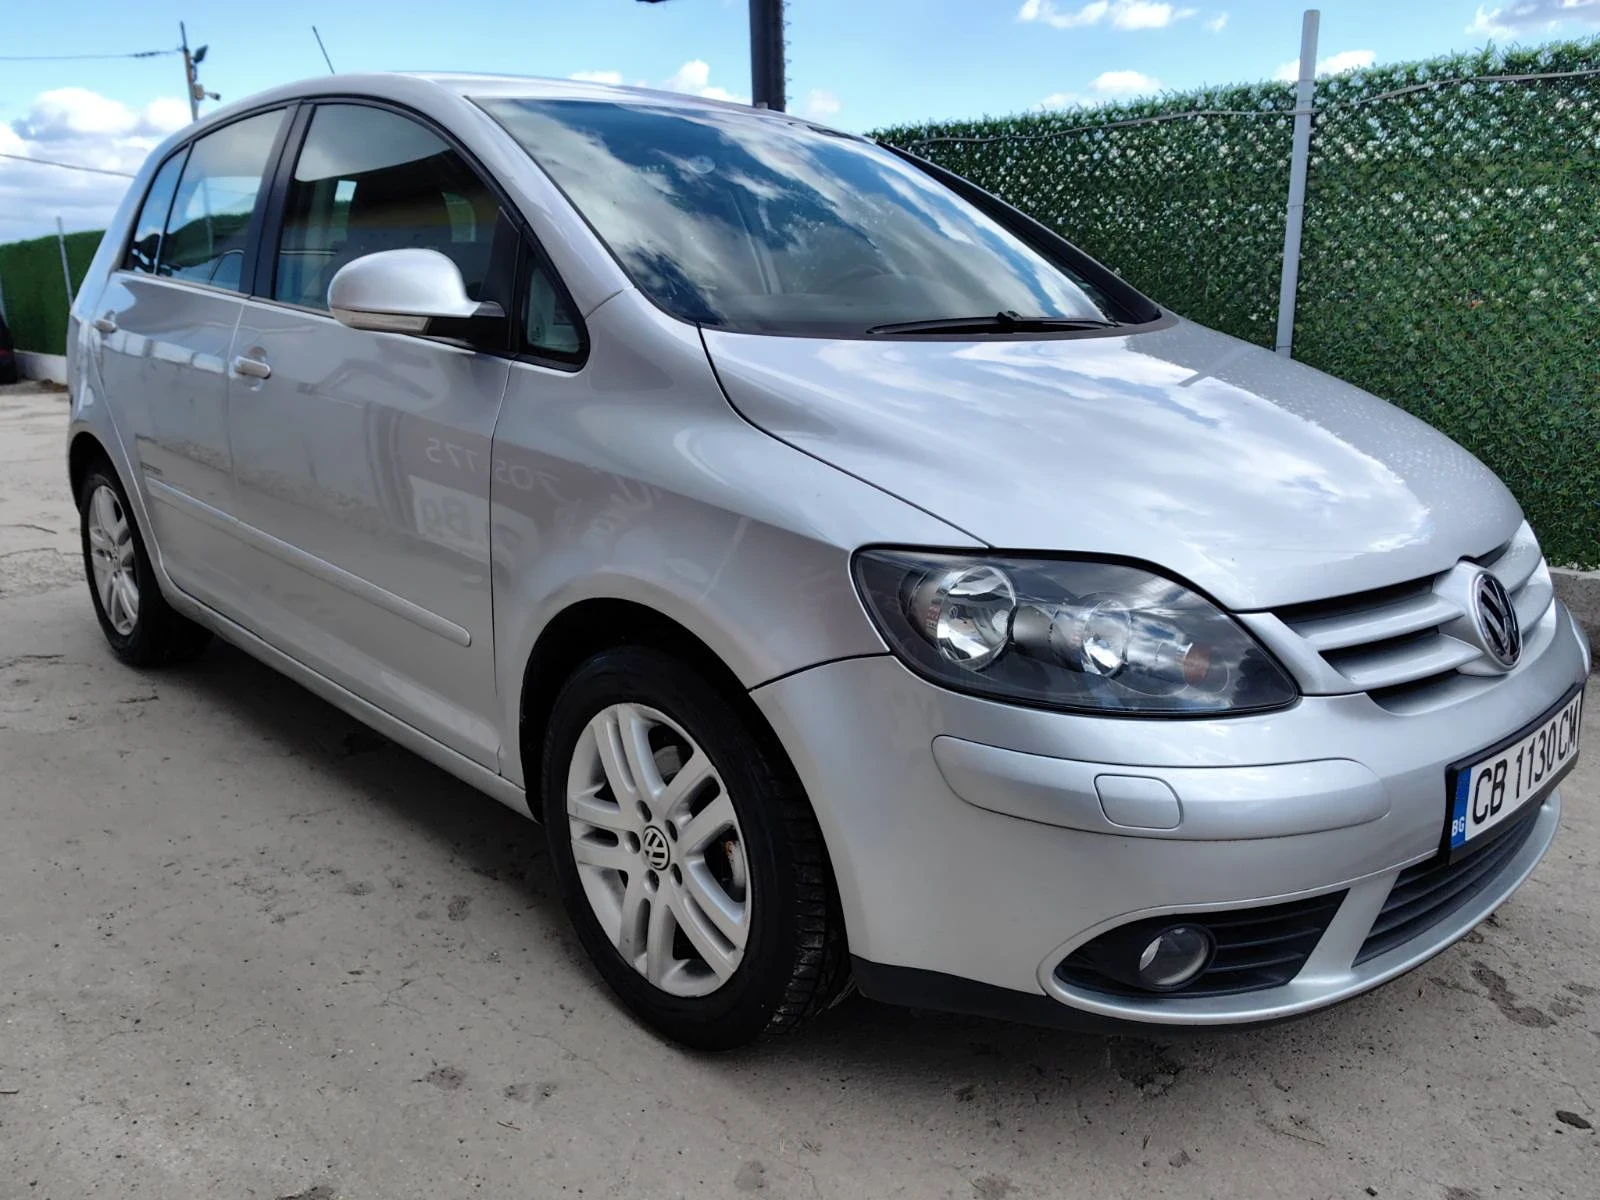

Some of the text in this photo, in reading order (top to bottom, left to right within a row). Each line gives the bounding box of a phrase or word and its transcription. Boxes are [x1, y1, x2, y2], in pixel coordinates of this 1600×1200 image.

[1473, 759, 1507, 825] CB
[1516, 721, 1556, 799] 1130
[1452, 816, 1465, 837] BG
